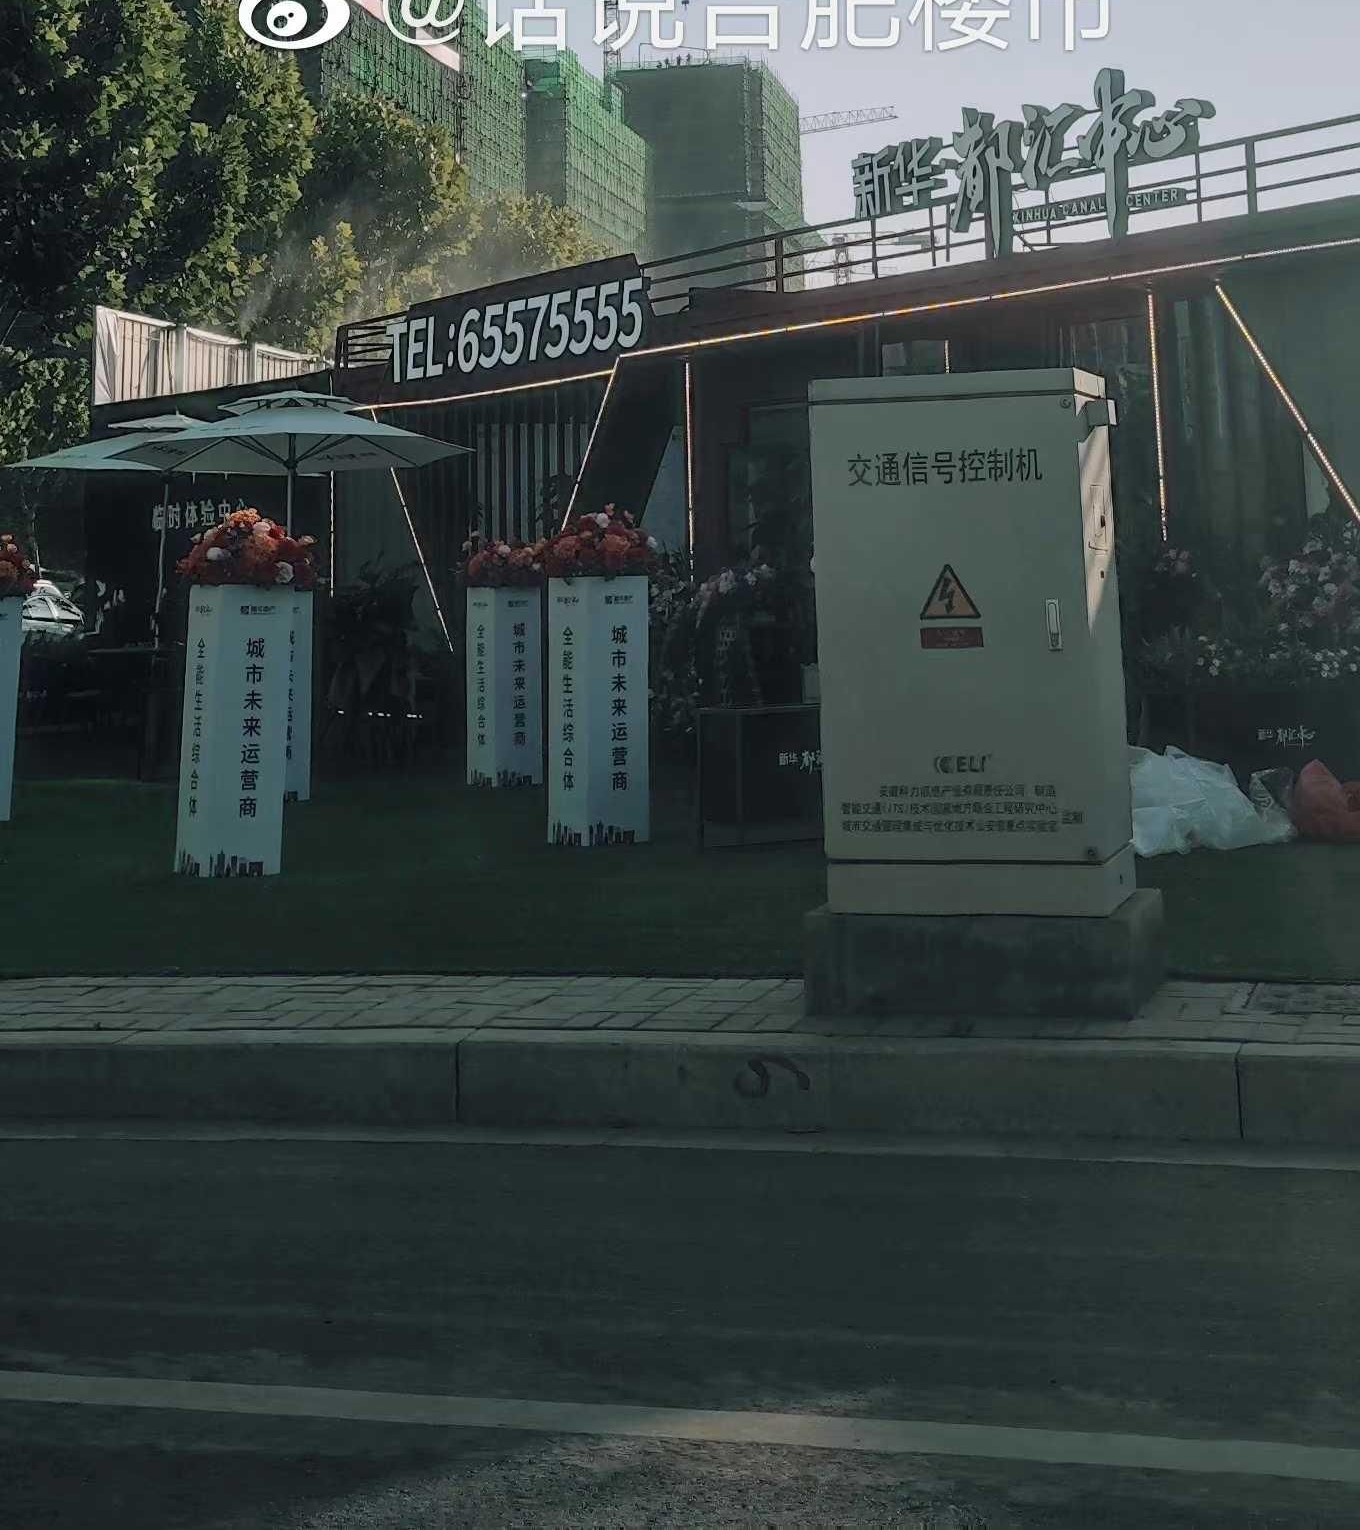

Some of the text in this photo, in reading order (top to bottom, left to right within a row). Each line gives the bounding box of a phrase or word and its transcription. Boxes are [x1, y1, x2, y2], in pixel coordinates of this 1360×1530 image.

[1062, 198, 1105, 216] CANAL
[1125, 189, 1179, 207] CENTER
[385, 277, 643, 383] TEL:65575555
[847, 448, 1043, 486] 交通信号控制机
[239, 637, 265, 818] 城市未来运营商
[513, 623, 526, 745] 城市未来运营商
[563, 626, 574, 791] 全能生活综合体
[611, 625, 629, 791] 城市未来运营商
